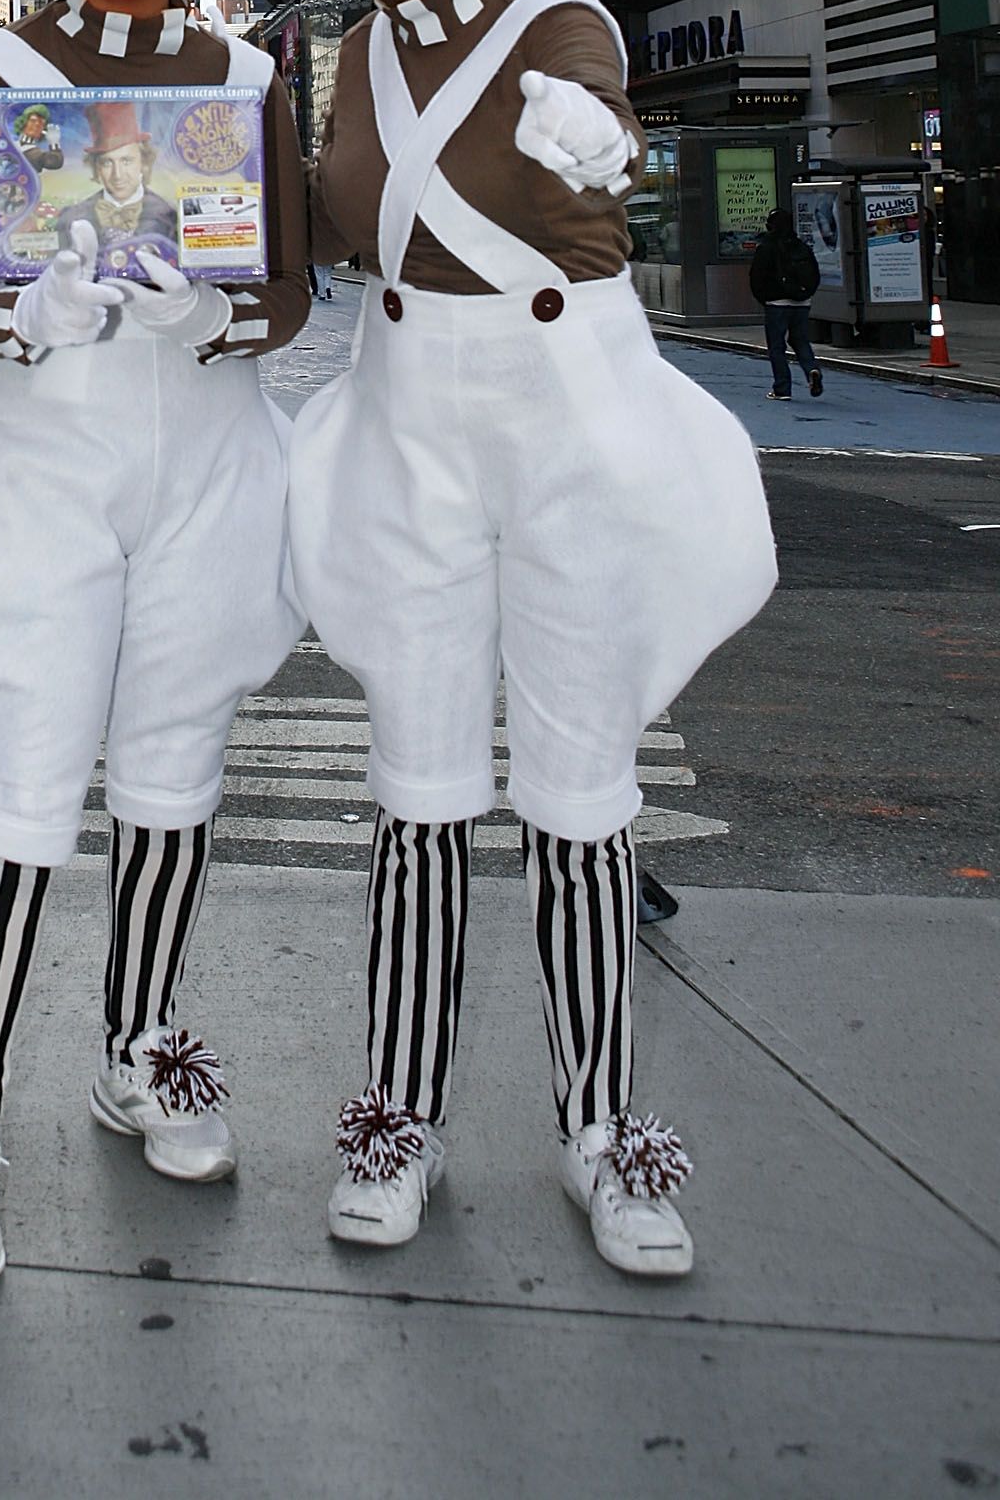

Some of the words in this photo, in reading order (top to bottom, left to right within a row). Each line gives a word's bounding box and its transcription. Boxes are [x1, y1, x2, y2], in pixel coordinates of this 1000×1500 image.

[7, 91, 60, 99] ANNIVERSARY
[62, 91, 95, 99] BLU-RAY
[103, 90, 117, 99] DVD
[134, 89, 172, 98] ULTIMATE
[227, 88, 259, 97] EDITION
[737, 94, 799, 104] SEPHORA
[194, 101, 239, 123] WILLY
[641, 114, 679, 122] PHORA
[732, 173, 755, 181] WHEN
[867, 198, 914, 213] CALLING
[869, 211, 885, 220] ALL
[886, 206, 916, 218] BRIDES
